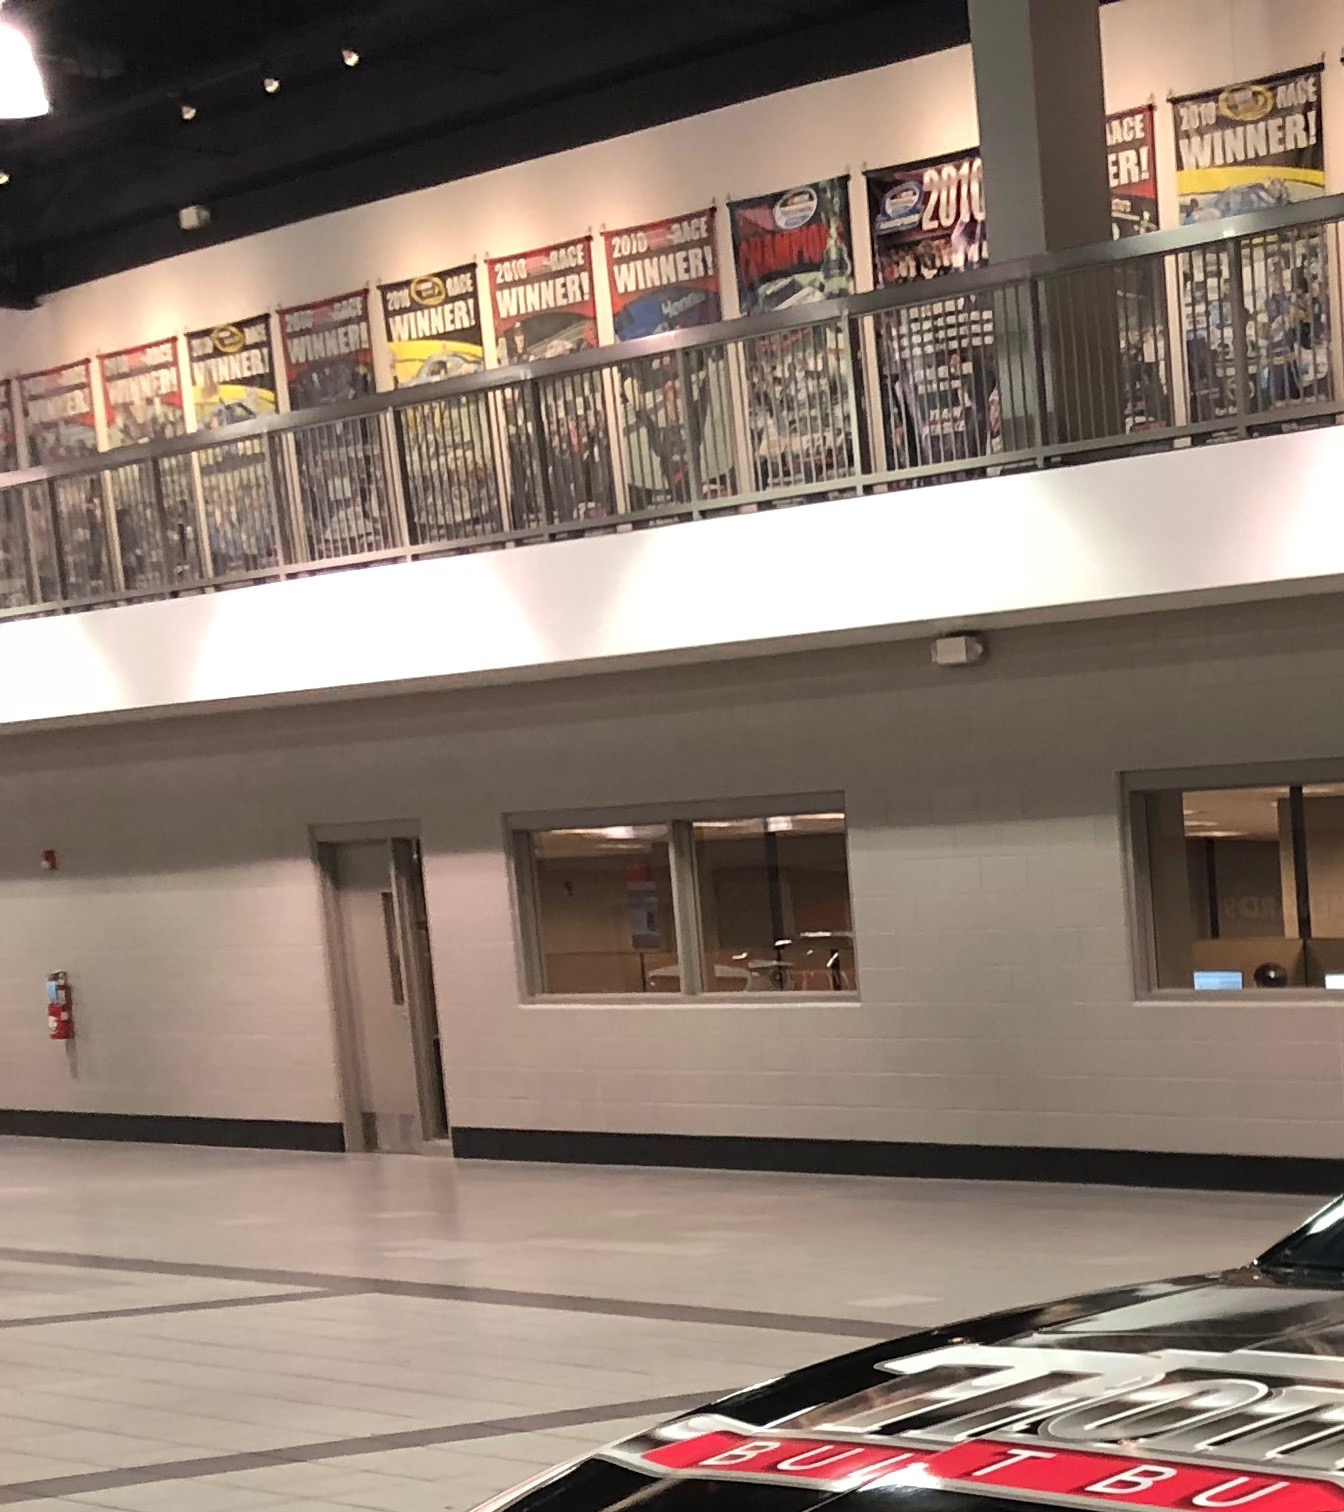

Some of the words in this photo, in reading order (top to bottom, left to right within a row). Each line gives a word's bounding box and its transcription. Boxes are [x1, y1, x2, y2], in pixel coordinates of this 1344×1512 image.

[1276, 77, 1318, 109] RACE
[1179, 110, 1317, 171] WINNER!
[611, 232, 648, 259] 2010
[493, 258, 528, 284] 2010
[612, 246, 714, 294] WINNER!
[496, 272, 590, 318] WINNER!
[388, 299, 476, 342] WINNER!
[288, 321, 370, 365] WINNER!
[191, 347, 271, 388] WINNER!
